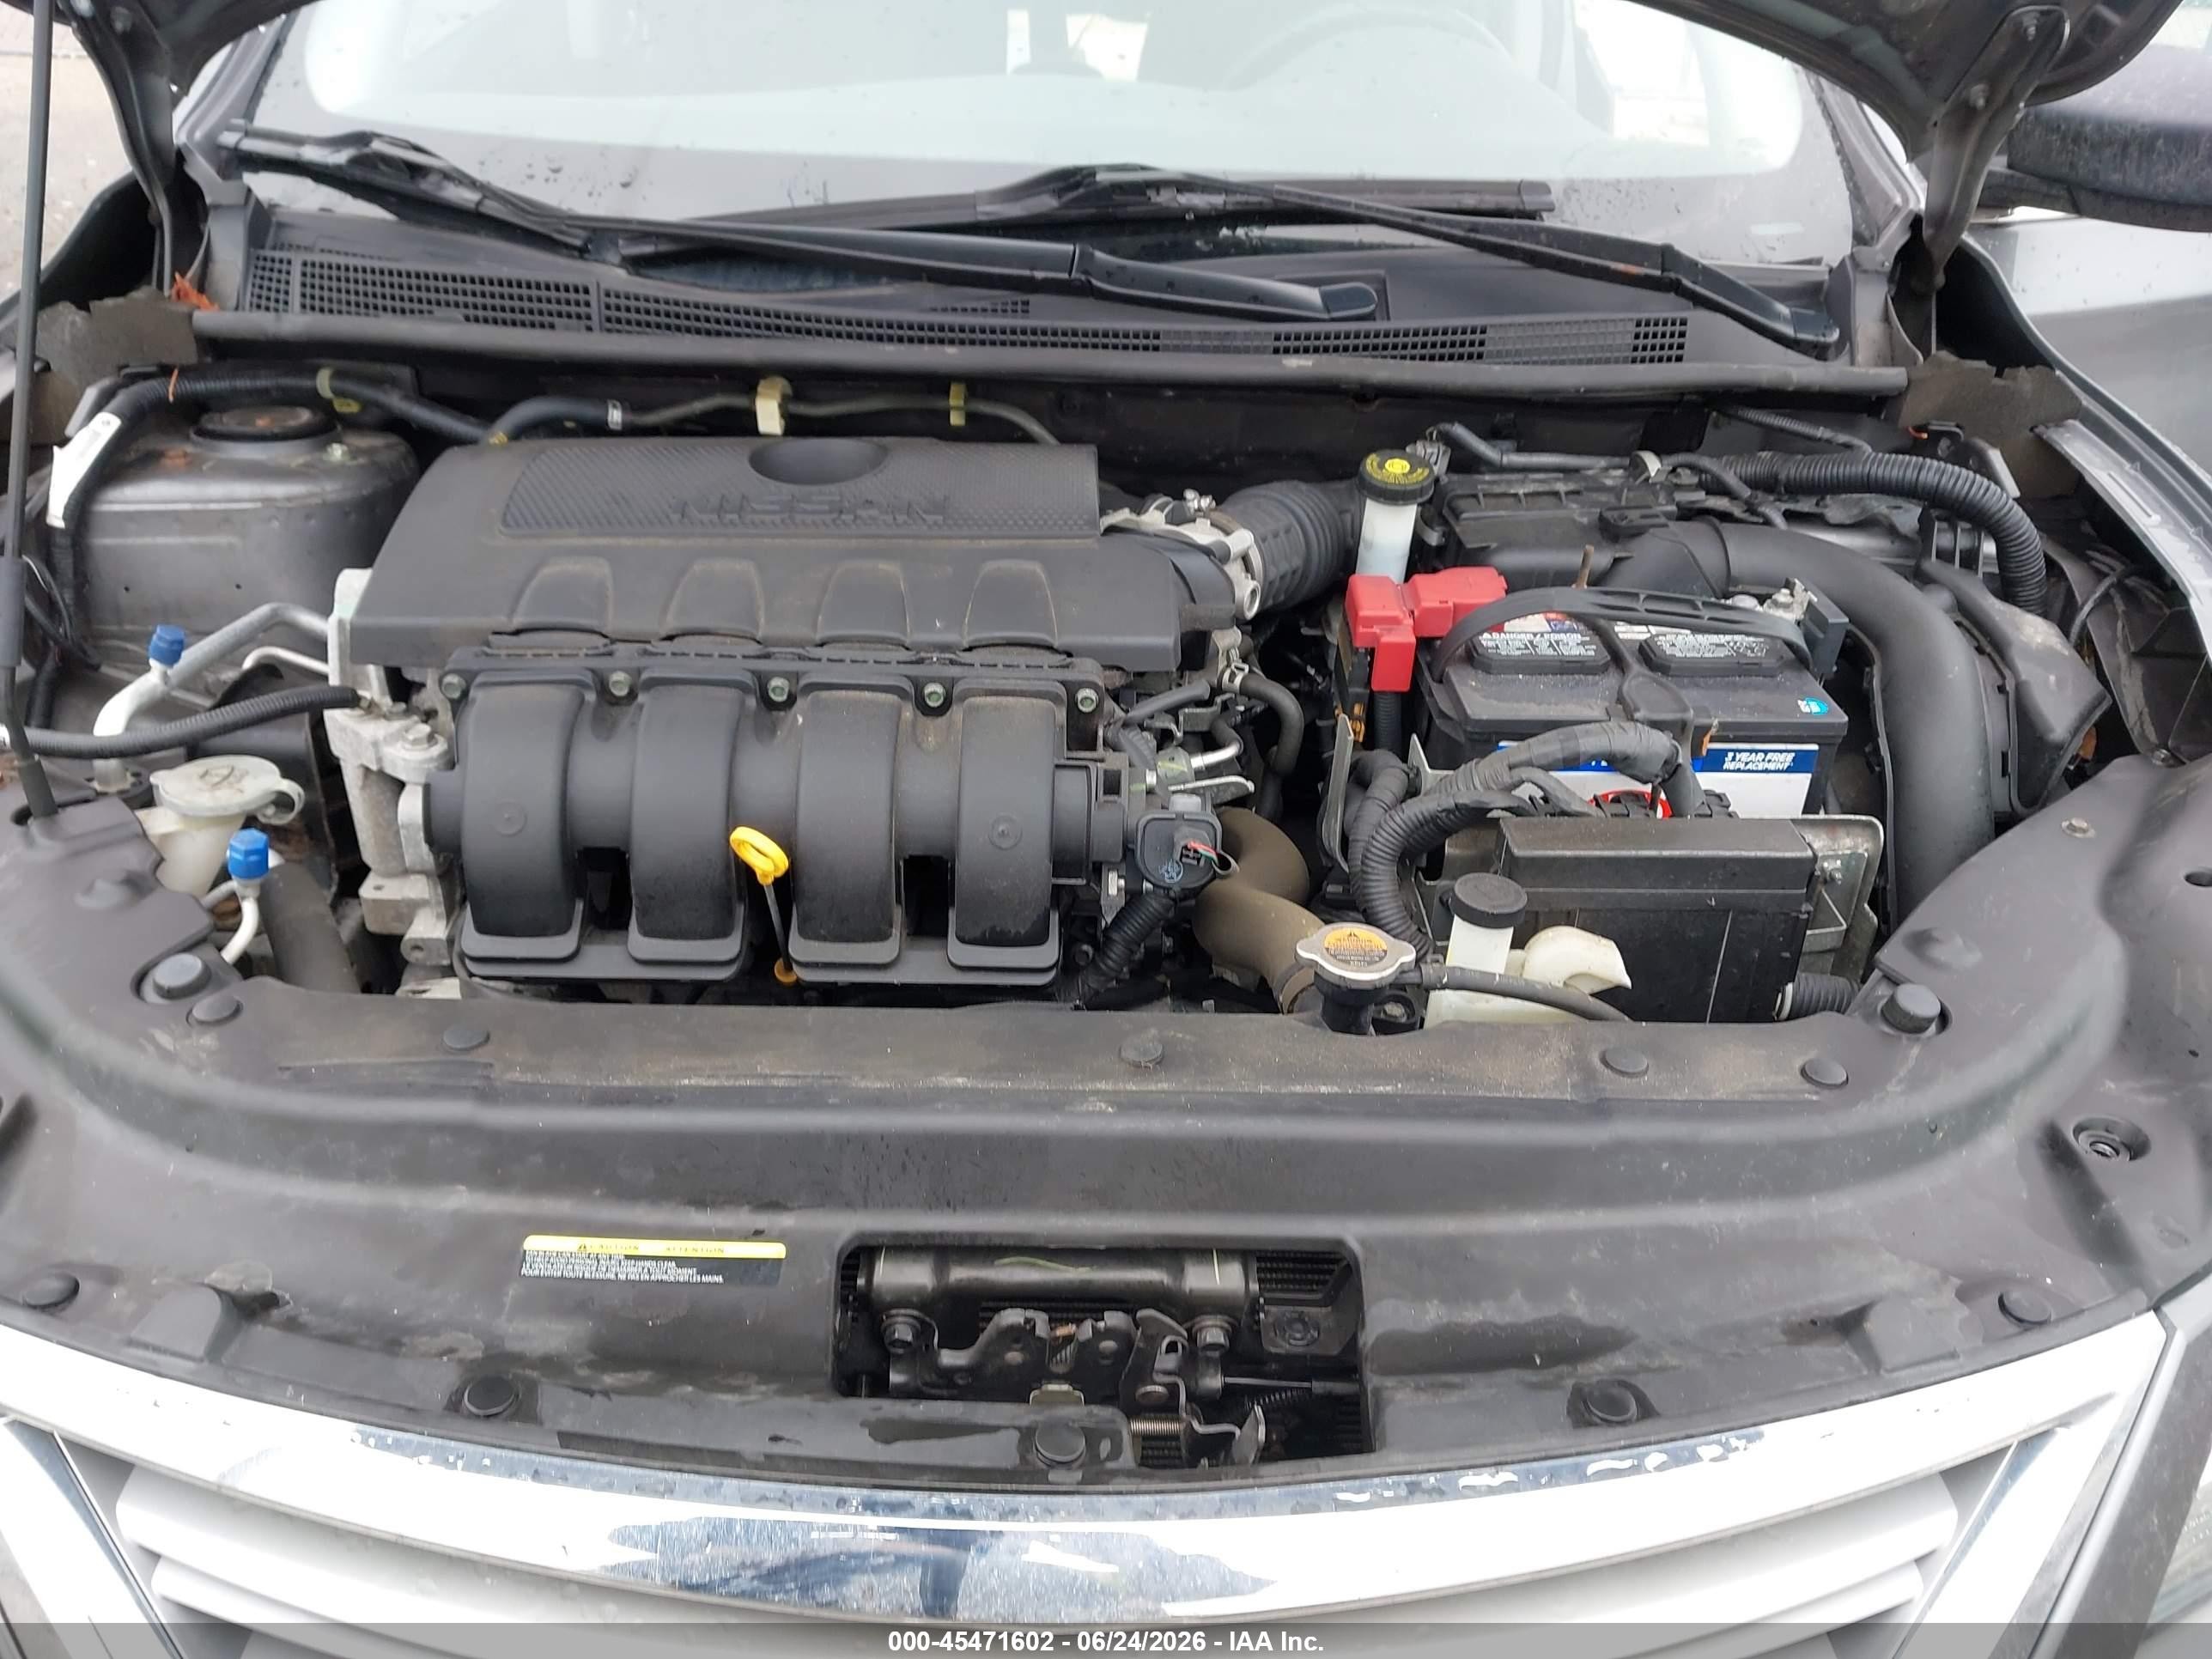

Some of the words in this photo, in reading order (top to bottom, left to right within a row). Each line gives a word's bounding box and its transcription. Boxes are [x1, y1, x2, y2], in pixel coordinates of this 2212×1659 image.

[673, 493, 948, 520] NISSAN
[1735, 751, 1765, 763] YEAR
[1765, 752, 1796, 763] FREE
